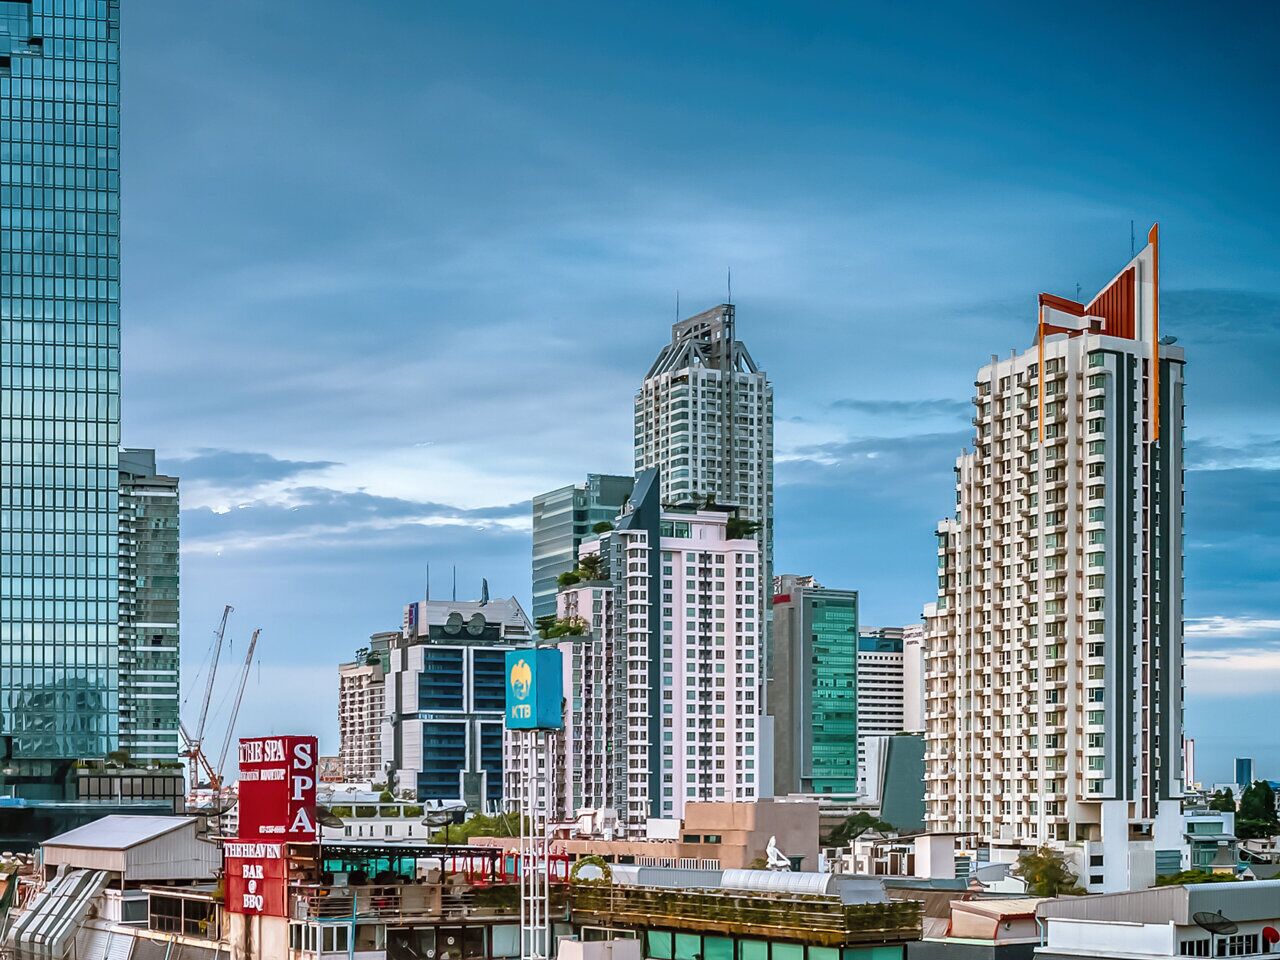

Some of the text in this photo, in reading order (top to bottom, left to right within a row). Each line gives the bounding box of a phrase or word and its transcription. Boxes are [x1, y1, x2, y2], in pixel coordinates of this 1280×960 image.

[511, 705, 531, 718] KTB
[264, 739, 286, 762] SPA
[289, 743, 315, 833] SPA
[240, 844, 281, 858] HEAVEN
[242, 864, 264, 879] BAR
[248, 879, 257, 893] @
[243, 894, 264, 911] BBQ
